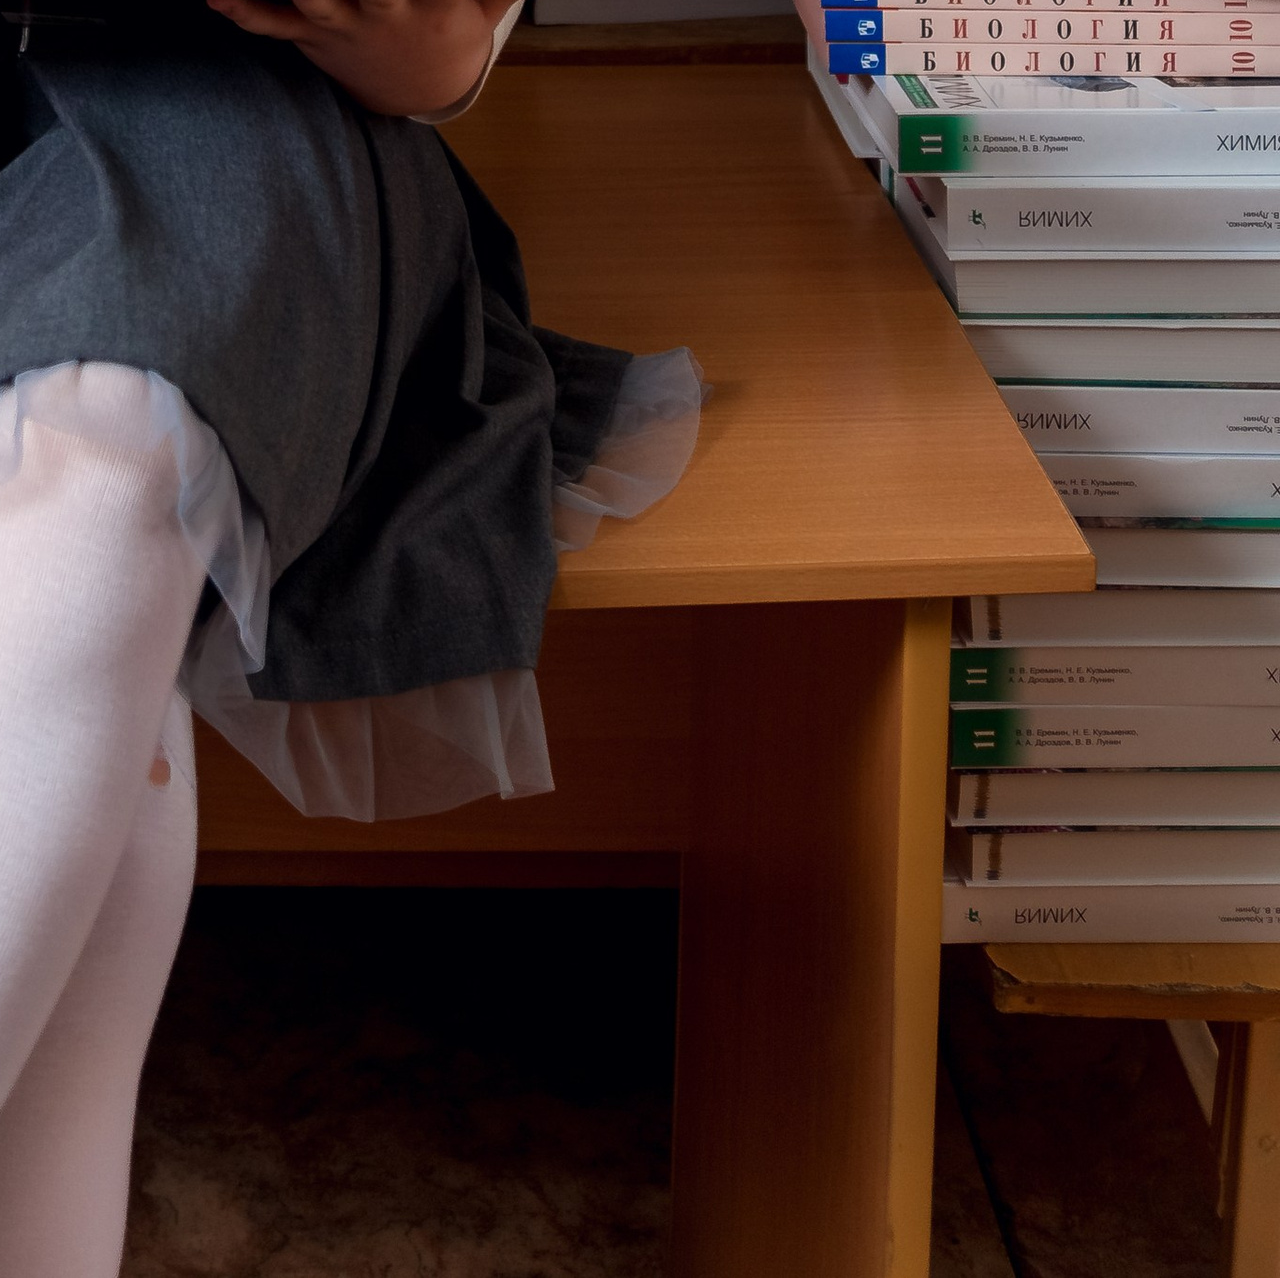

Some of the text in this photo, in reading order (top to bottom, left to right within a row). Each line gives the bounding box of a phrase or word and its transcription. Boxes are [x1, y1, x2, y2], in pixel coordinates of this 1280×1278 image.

[920, 18, 1253, 42] БИОЛОГИЯ 10
[923, 51, 1256, 74] БИОЛОГИЯ 10
[963, 135, 1085, 144] В. В. Еремин, Н. Е. Кузьменко,
[1217, 134, 1280, 151] ХИМИ
[963, 145, 1069, 154] А. А. Дроздов, В. В. Лунин
[1018, 210, 1093, 228] ХИМИЯ
[1243, 210, 1269, 220] Лунин
[1017, 413, 1092, 430] ХИМИЯ
[1243, 415, 1269, 424] Лунин
[1070, 479, 1078, 488] Н.
[1081, 479, 1089, 488] Е.
[1091, 479, 1138, 488] Кузьменко,
[1072, 488, 1081, 496] В.
[1084, 488, 1092, 496] В.
[1093, 488, 1120, 496] Лунин
[1009, 667, 1132, 676] В. В. Еремин, Н. Е. Кузьменко,
[1009, 676, 1115, 684] А. А. Дроздов, В. В. Лунин
[1015, 729, 1139, 738] В. В. Еремин, Н. Е. Кузьменко,
[1015, 738, 1121, 747] А. А. Дроздов, В. В. Лунин
[1014, 907, 1087, 924] ХИМИЯ
[1235, 907, 1260, 915] Лунин
